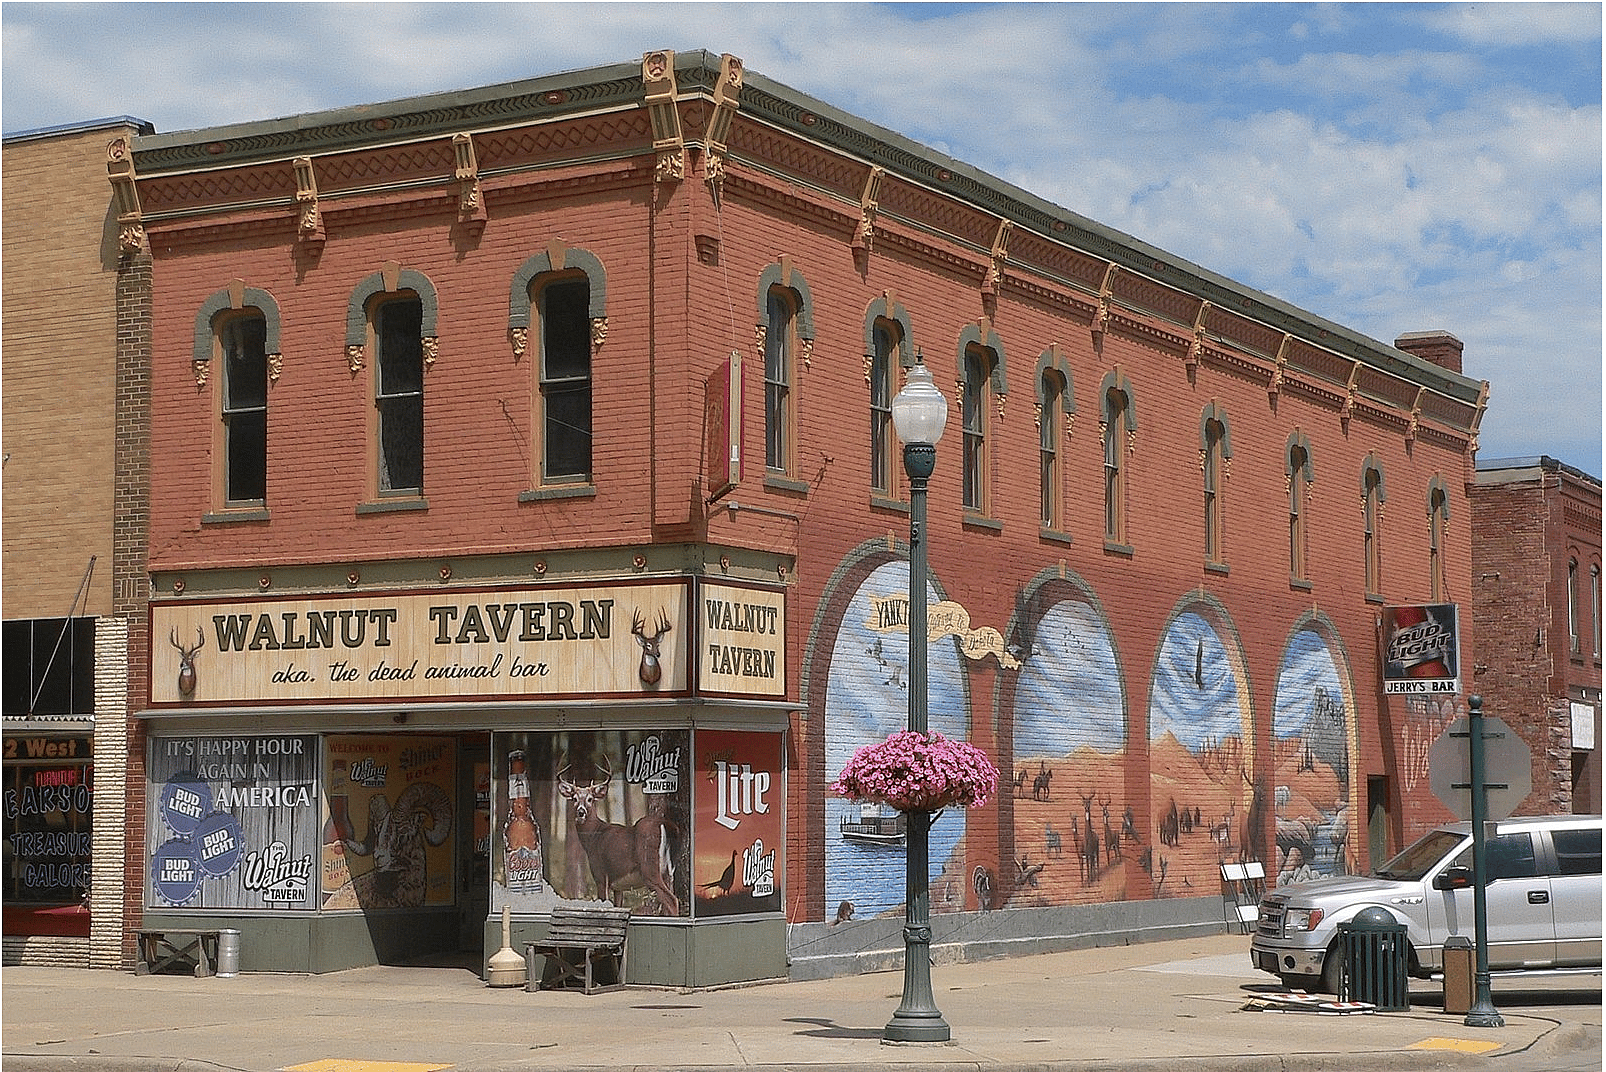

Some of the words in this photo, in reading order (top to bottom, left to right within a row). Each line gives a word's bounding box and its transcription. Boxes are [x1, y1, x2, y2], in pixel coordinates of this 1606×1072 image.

[213, 608, 397, 651] WALNUT
[429, 599, 614, 644] TAVERN
[706, 599, 777, 635] WALNUT
[1396, 625, 1440, 646] BUD
[1390, 633, 1450, 661] LIGHT
[272, 663, 315, 683] aka.
[329, 660, 360, 682] the
[368, 659, 418, 682] dead
[424, 653, 503, 680] animal
[509, 656, 549, 678] bar
[710, 644, 775, 679] TAVERN
[1387, 682, 1426, 692] JERRY'S
[1432, 682, 1455, 691] BAR
[26, 738, 77, 757] West
[167, 740, 195, 756] IT'S
[199, 739, 250, 756] HAPPY
[255, 739, 303, 755] HOUR
[378, 744, 390, 753] TO
[197, 763, 247, 779] AGAIN
[253, 763, 270, 778] IN
[625, 740, 681, 784] Walnut
[649, 781, 677, 791] TAVERN
[714, 761, 770, 831] Lite
[175, 788, 200, 806] BUD
[215, 787, 310, 807] AMERICA
[169, 798, 202, 819] LIGHT
[203, 829, 229, 848] BUD
[201, 837, 236, 862] LIGHT
[165, 859, 190, 871] BUD
[244, 848, 312, 890] Walnut
[743, 847, 776, 887] Walnut
[160, 870, 194, 882] LIGHT
[270, 888, 305, 900] TAVERN
